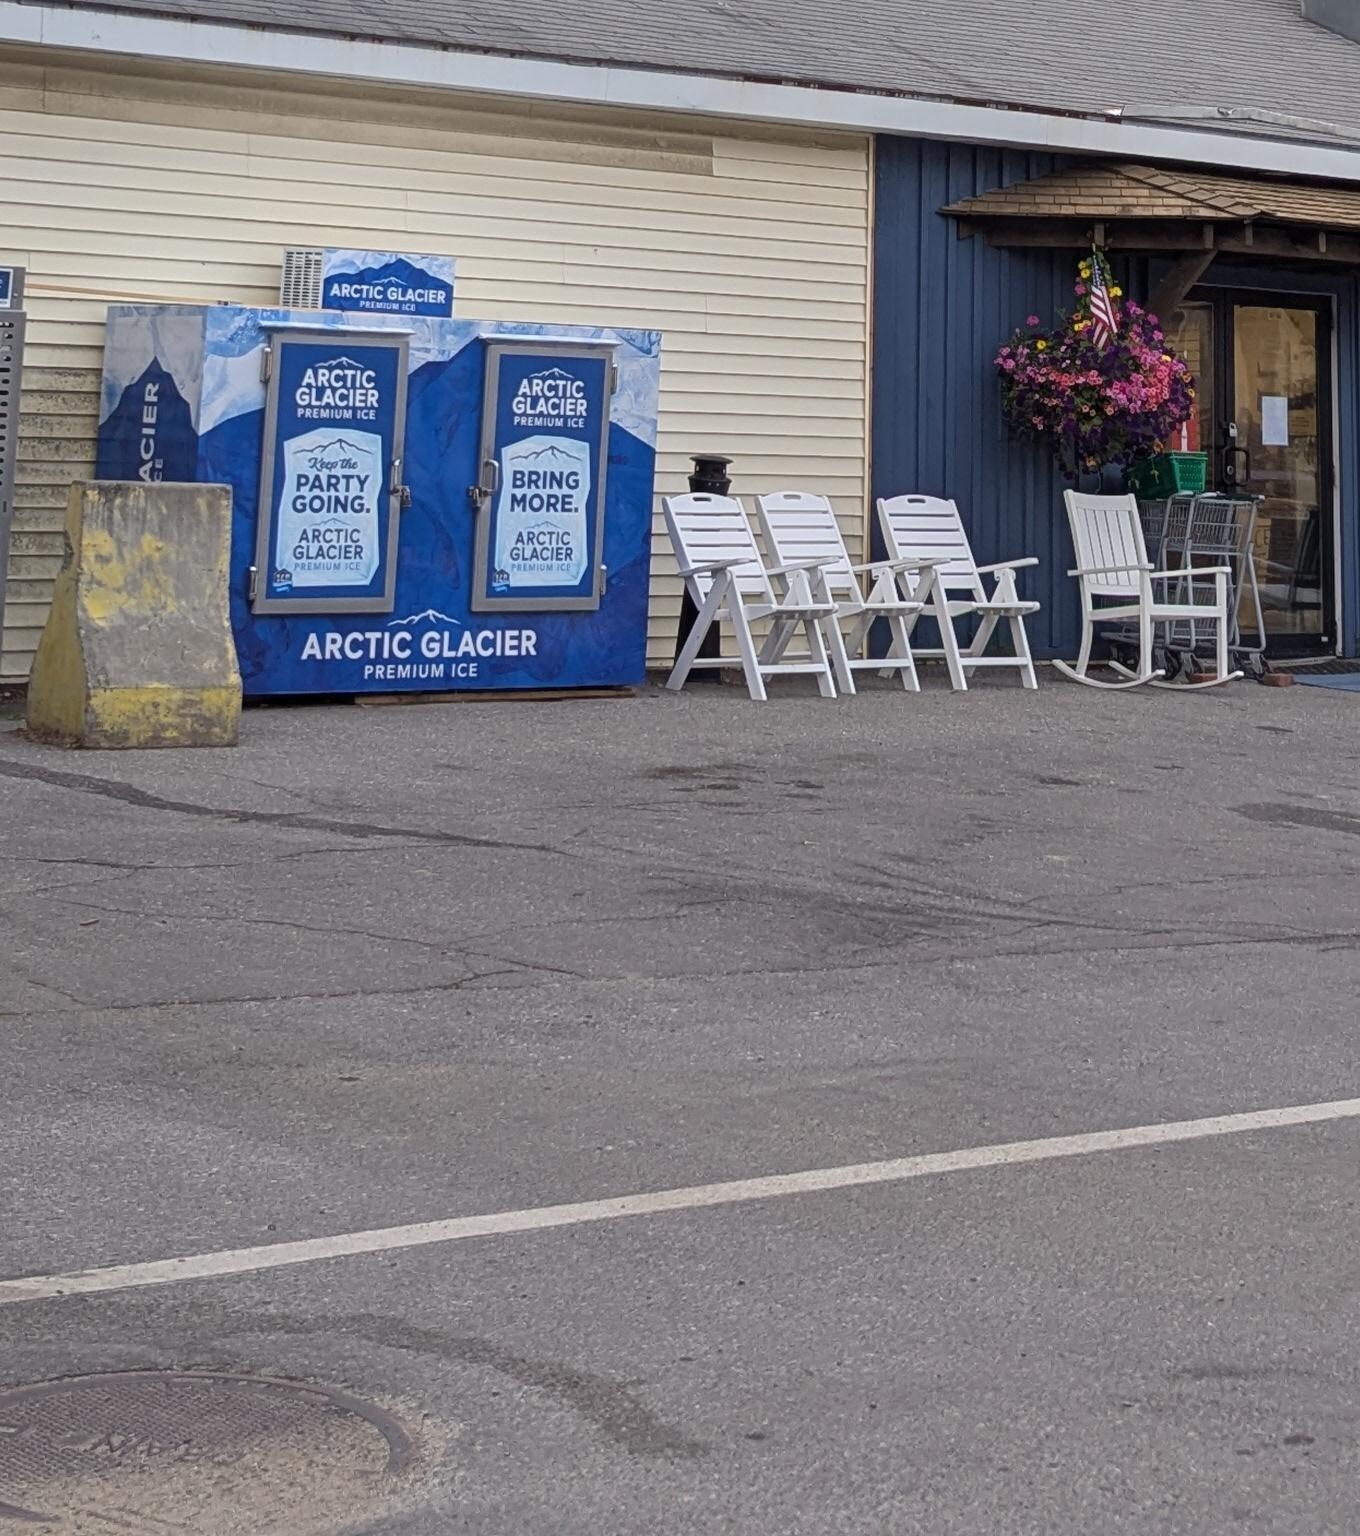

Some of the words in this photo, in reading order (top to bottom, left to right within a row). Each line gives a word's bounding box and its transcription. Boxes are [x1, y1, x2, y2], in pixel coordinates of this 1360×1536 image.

[329, 283, 384, 300] ARCTIC
[386, 286, 447, 304] GLACIER
[359, 300, 400, 310] PREMIUM
[301, 368, 376, 389] ARCTIC
[517, 378, 585, 398] ARCTIC
[295, 387, 379, 408] GLACIER
[512, 396, 588, 417] GLACIER
[296, 407, 353, 420] PREMIUM
[356, 409, 377, 420] ICE
[513, 416, 564, 427] PREMIUM
[566, 417, 585, 428] ICE
[138, 382, 160, 482] ACIER
[308, 456, 338, 473] Keep
[339, 458, 359, 470] the
[295, 473, 371, 493] PARTY
[511, 470, 580, 490] BRING
[291, 494, 371, 514] GOING.
[509, 493, 579, 513] MORE.
[298, 528, 361, 544] ARCTIC
[514, 531, 571, 546] ARCTIC
[292, 545, 364, 560] GLACIER
[509, 547, 574, 562] GLACIER
[293, 561, 340, 571] PREMIUM
[344, 562, 361, 571] ICE
[511, 563, 553, 572] PREMIUM
[556, 563, 571, 572] ICE
[300, 631, 413, 661] ARCTIC
[420, 629, 537, 659] GLACIER
[363, 663, 444, 680] PREMIUM
[451, 662, 478, 678] ICE
